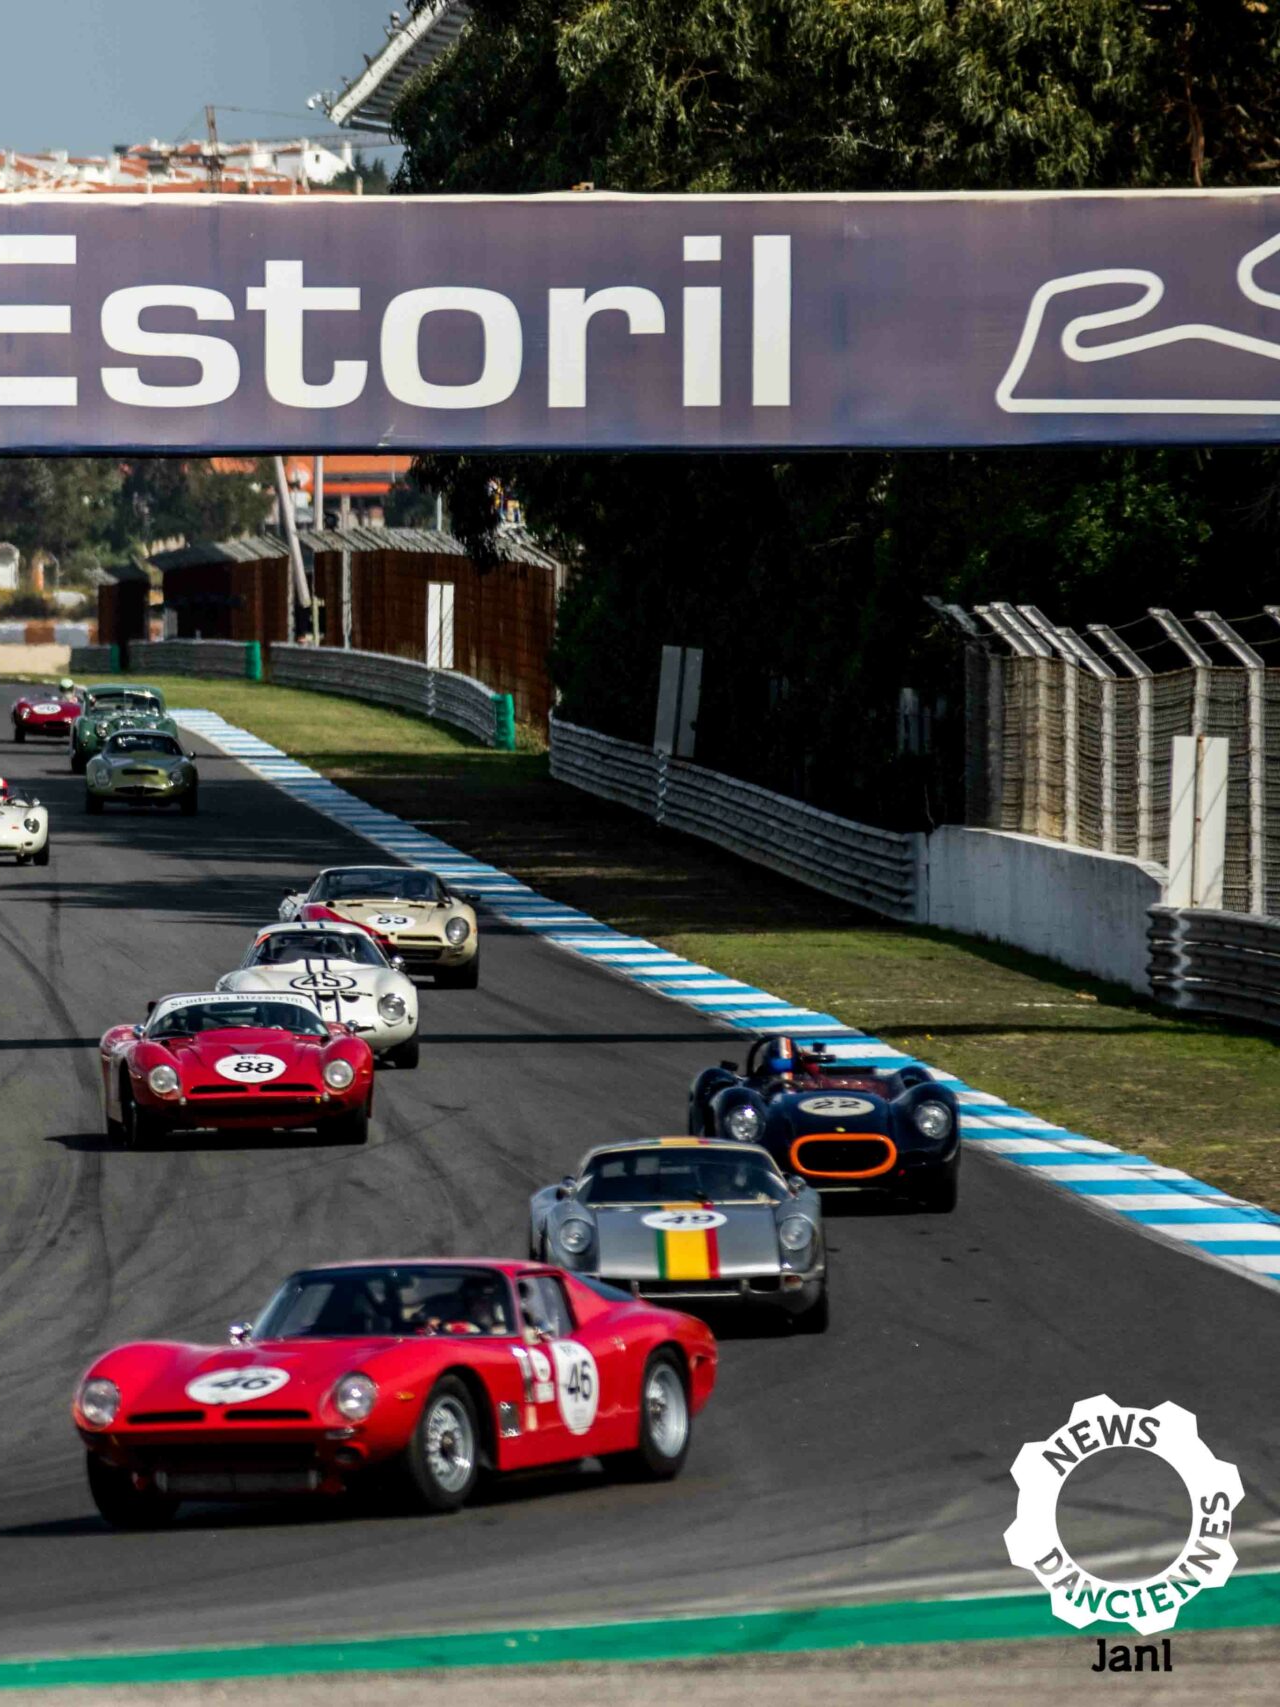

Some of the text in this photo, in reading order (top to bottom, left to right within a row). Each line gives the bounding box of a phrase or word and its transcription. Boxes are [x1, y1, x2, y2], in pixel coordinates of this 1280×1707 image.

[377, 916, 408, 925] 53
[301, 973, 341, 987] 45
[233, 1061, 274, 1073] 88
[813, 1100, 861, 1109] 22
[211, 1375, 279, 1390] 46
[567, 1360, 592, 1402] 46
